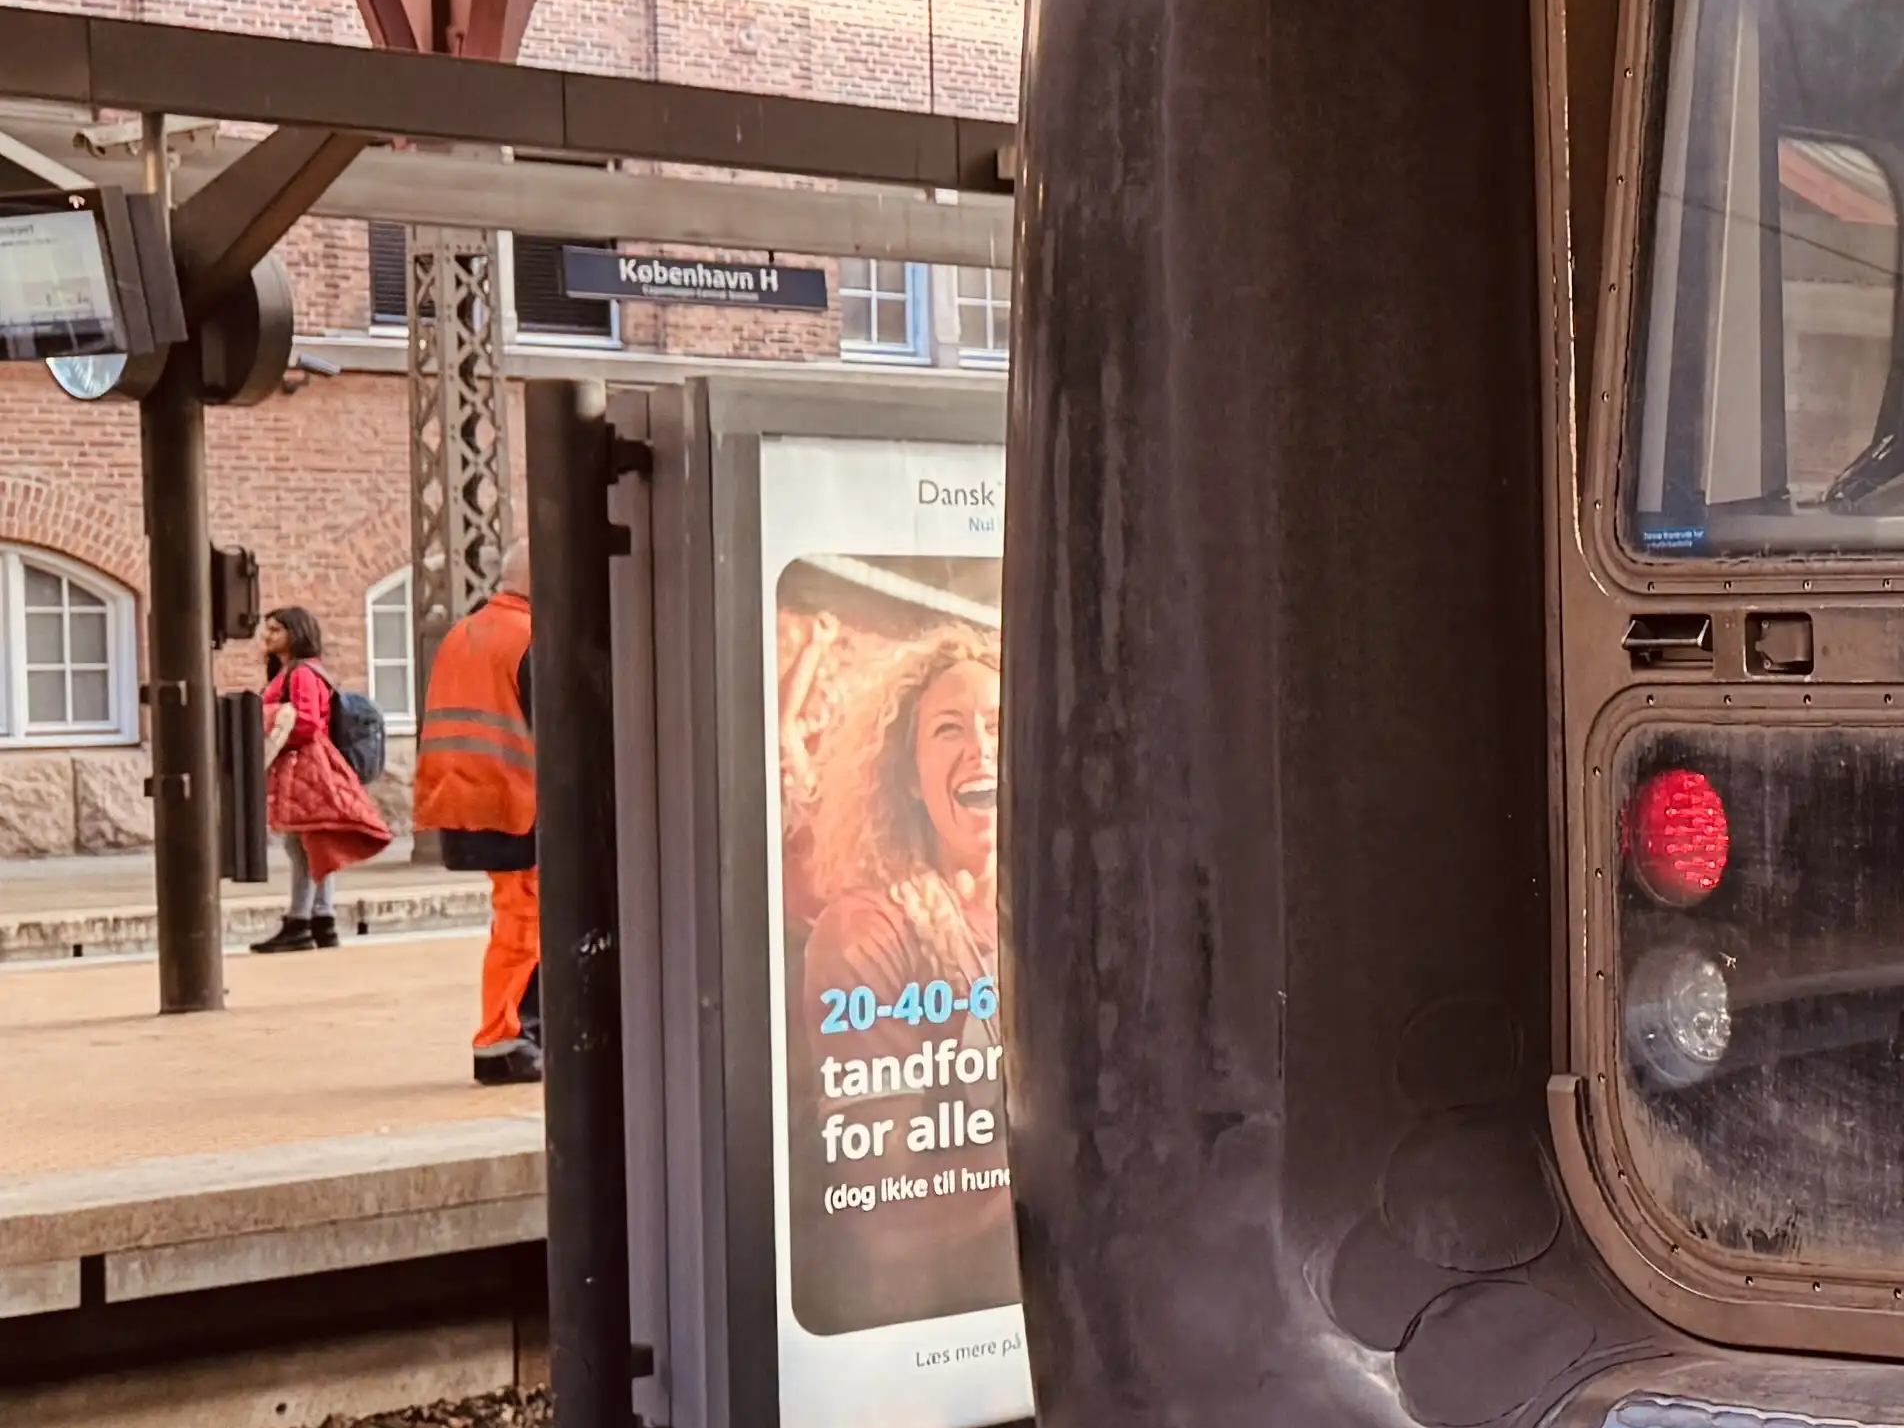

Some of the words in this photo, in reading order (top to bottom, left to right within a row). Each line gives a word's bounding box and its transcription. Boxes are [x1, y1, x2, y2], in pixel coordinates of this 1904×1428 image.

[619, 258, 754, 290] København
[760, 268, 779, 292] H
[918, 479, 995, 507] Dansk
[820, 1038, 1003, 1098] tandfor
[821, 1114, 895, 1163] for
[907, 1100, 995, 1152] alle
[824, 1183, 876, 1214] (dog
[881, 1175, 929, 1202] ikke
[933, 1169, 956, 1196] til
[956, 1340, 997, 1362] mere
